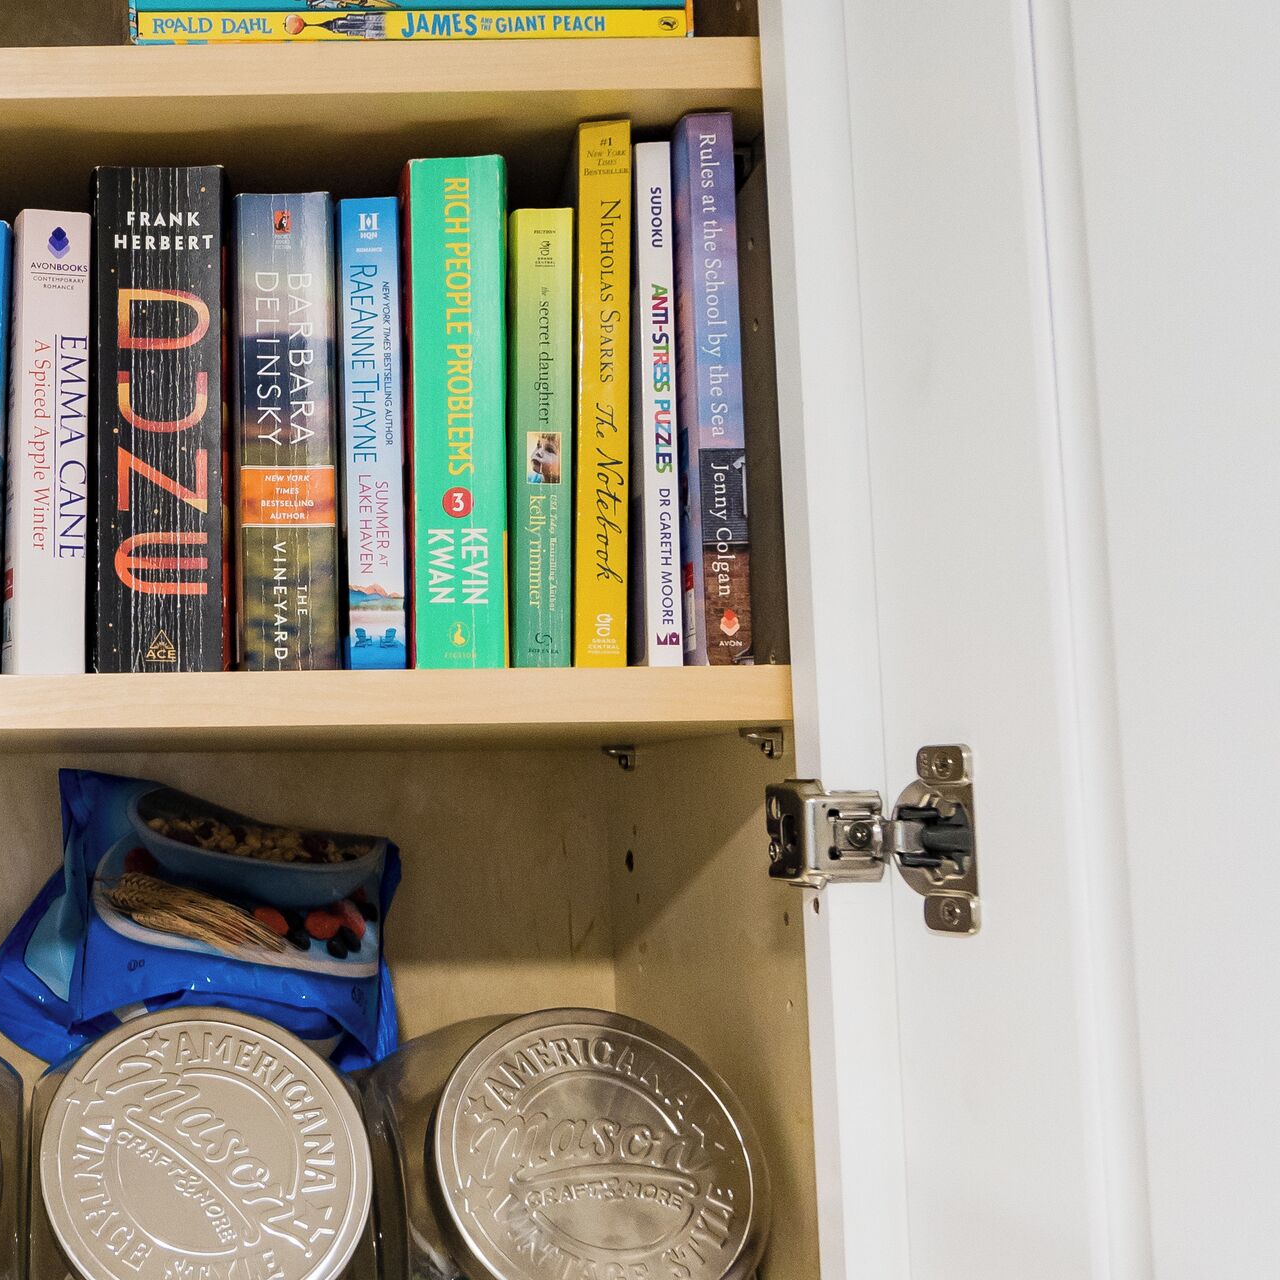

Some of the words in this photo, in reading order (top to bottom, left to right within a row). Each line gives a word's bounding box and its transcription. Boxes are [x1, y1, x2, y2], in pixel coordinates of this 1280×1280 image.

[153, 17, 212, 33] ROALD
[221, 16, 272, 33] DAHL
[401, 12, 477, 36] JAMES
[496, 16, 545, 33] GIANT
[551, 14, 605, 31] PEACH
[699, 133, 720, 189] Rules
[127, 212, 200, 226] FRANK
[443, 177, 469, 234] RICH
[650, 186, 662, 248] SUDOKU
[702, 194, 716, 212] at
[703, 218, 723, 252] the
[31, 262, 88, 272] AVONBOOKS
[114, 235, 213, 250] HERBERT
[599, 200, 622, 307] NICHOLAS
[349, 264, 377, 369] RAEANNE
[445, 242, 472, 334] PEOPLE
[537, 300, 550, 346] secret
[705, 258, 727, 326] School
[255, 272, 281, 446] DELINSKY
[288, 273, 314, 445] BARBARA
[599, 311, 623, 383] SPARKS
[651, 283, 671, 394] ANTI-STRESS
[702, 334, 728, 358] by
[60, 335, 87, 448] EMMA
[446, 341, 475, 476] PROBLEMS
[533, 350, 550, 424] daughter
[710, 364, 728, 396] the
[352, 374, 380, 463] THAYNE
[595, 402, 617, 446] The
[655, 399, 673, 473] PUZZLES
[711, 402, 730, 437] Sea
[59, 460, 87, 558] CANE
[452, 493, 464, 511] 3
[595, 447, 624, 583] Notebook
[710, 463, 729, 520] Jenny
[427, 528, 455, 604] KWAN
[461, 528, 488, 605] KEVIN
[712, 527, 736, 597] Colgan
[272, 542, 288, 659] VINEYARD
[296, 585, 307, 616] THE
[175, 1031, 338, 1196] AMERICANA
